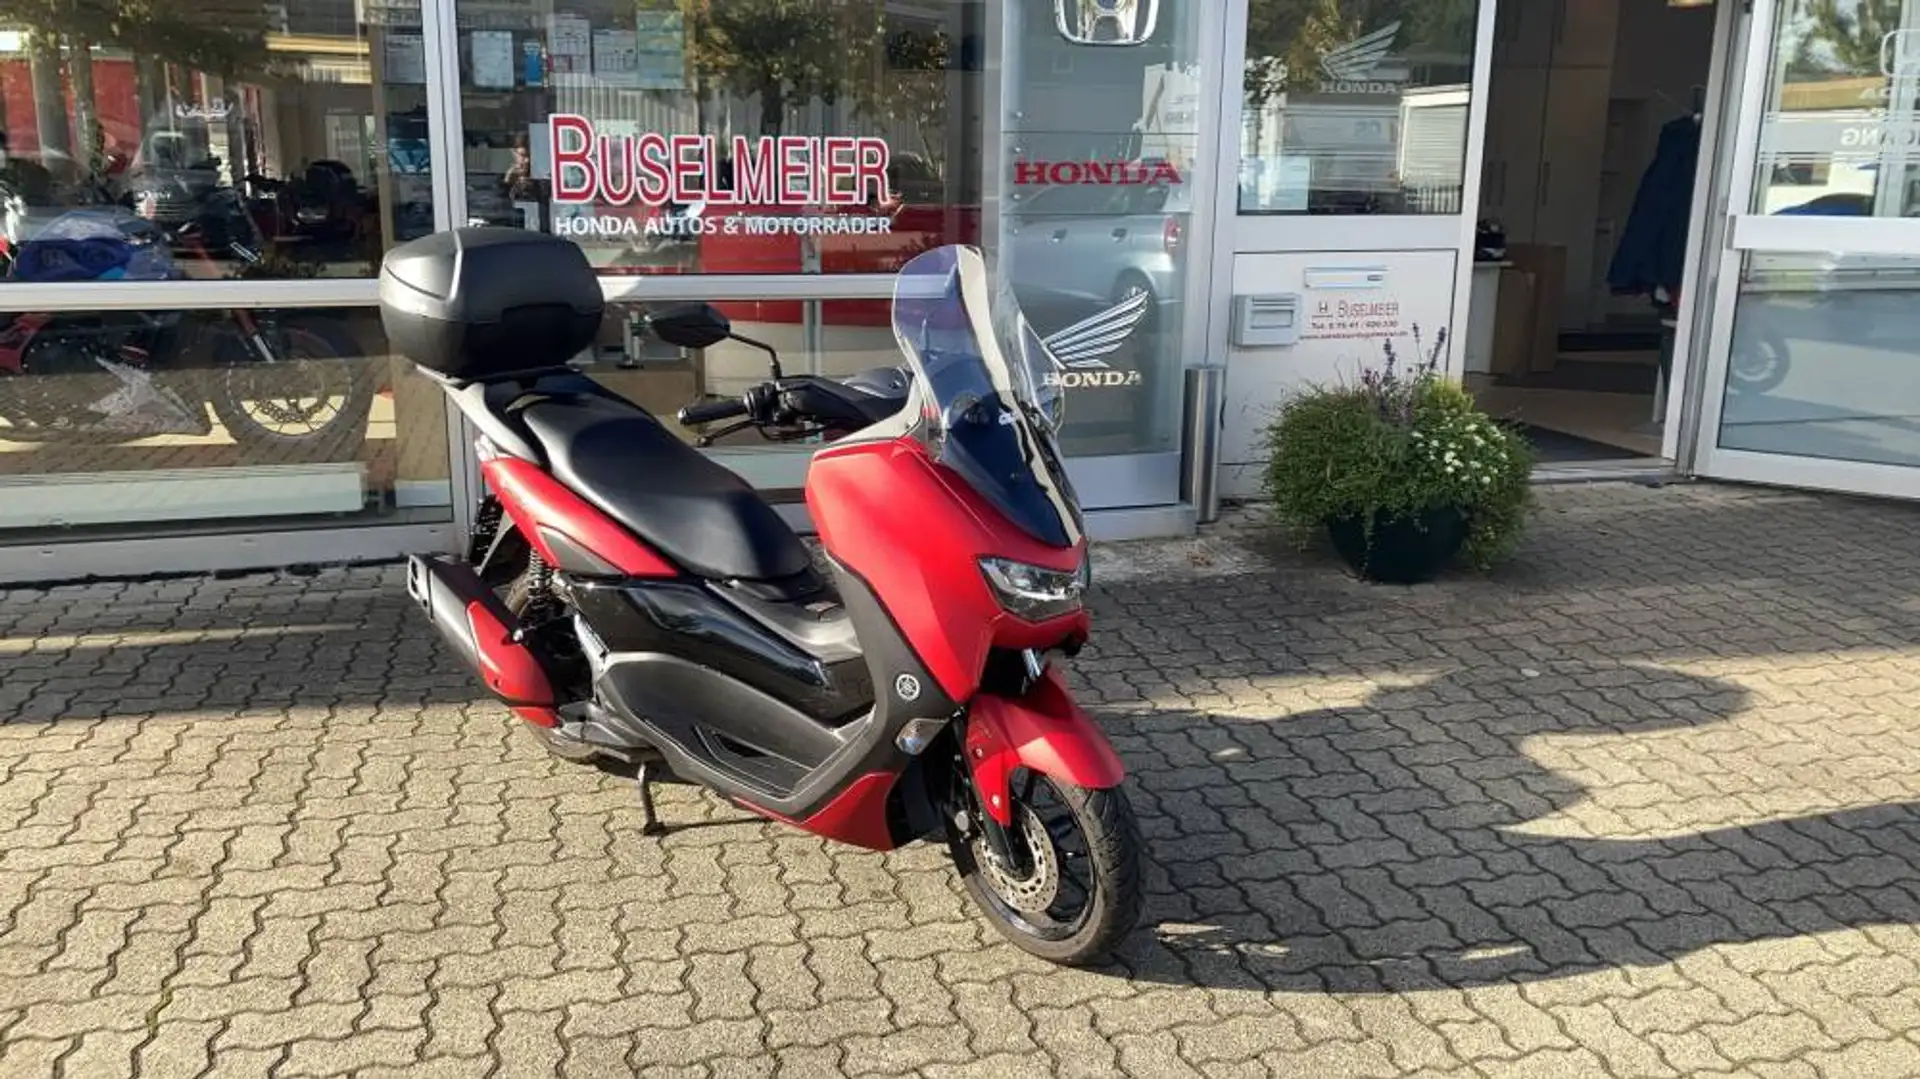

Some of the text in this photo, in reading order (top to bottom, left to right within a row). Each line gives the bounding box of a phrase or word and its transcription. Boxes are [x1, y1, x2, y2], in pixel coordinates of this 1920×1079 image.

[1319, 81, 1398, 94] HONDA
[549, 114, 890, 206] BUSELMEIER
[1014, 161, 1183, 185] HONDA
[555, 212, 892, 236] HONDA AUTOS & MOTORRÄDER
[1042, 371, 1142, 388] HONDA
